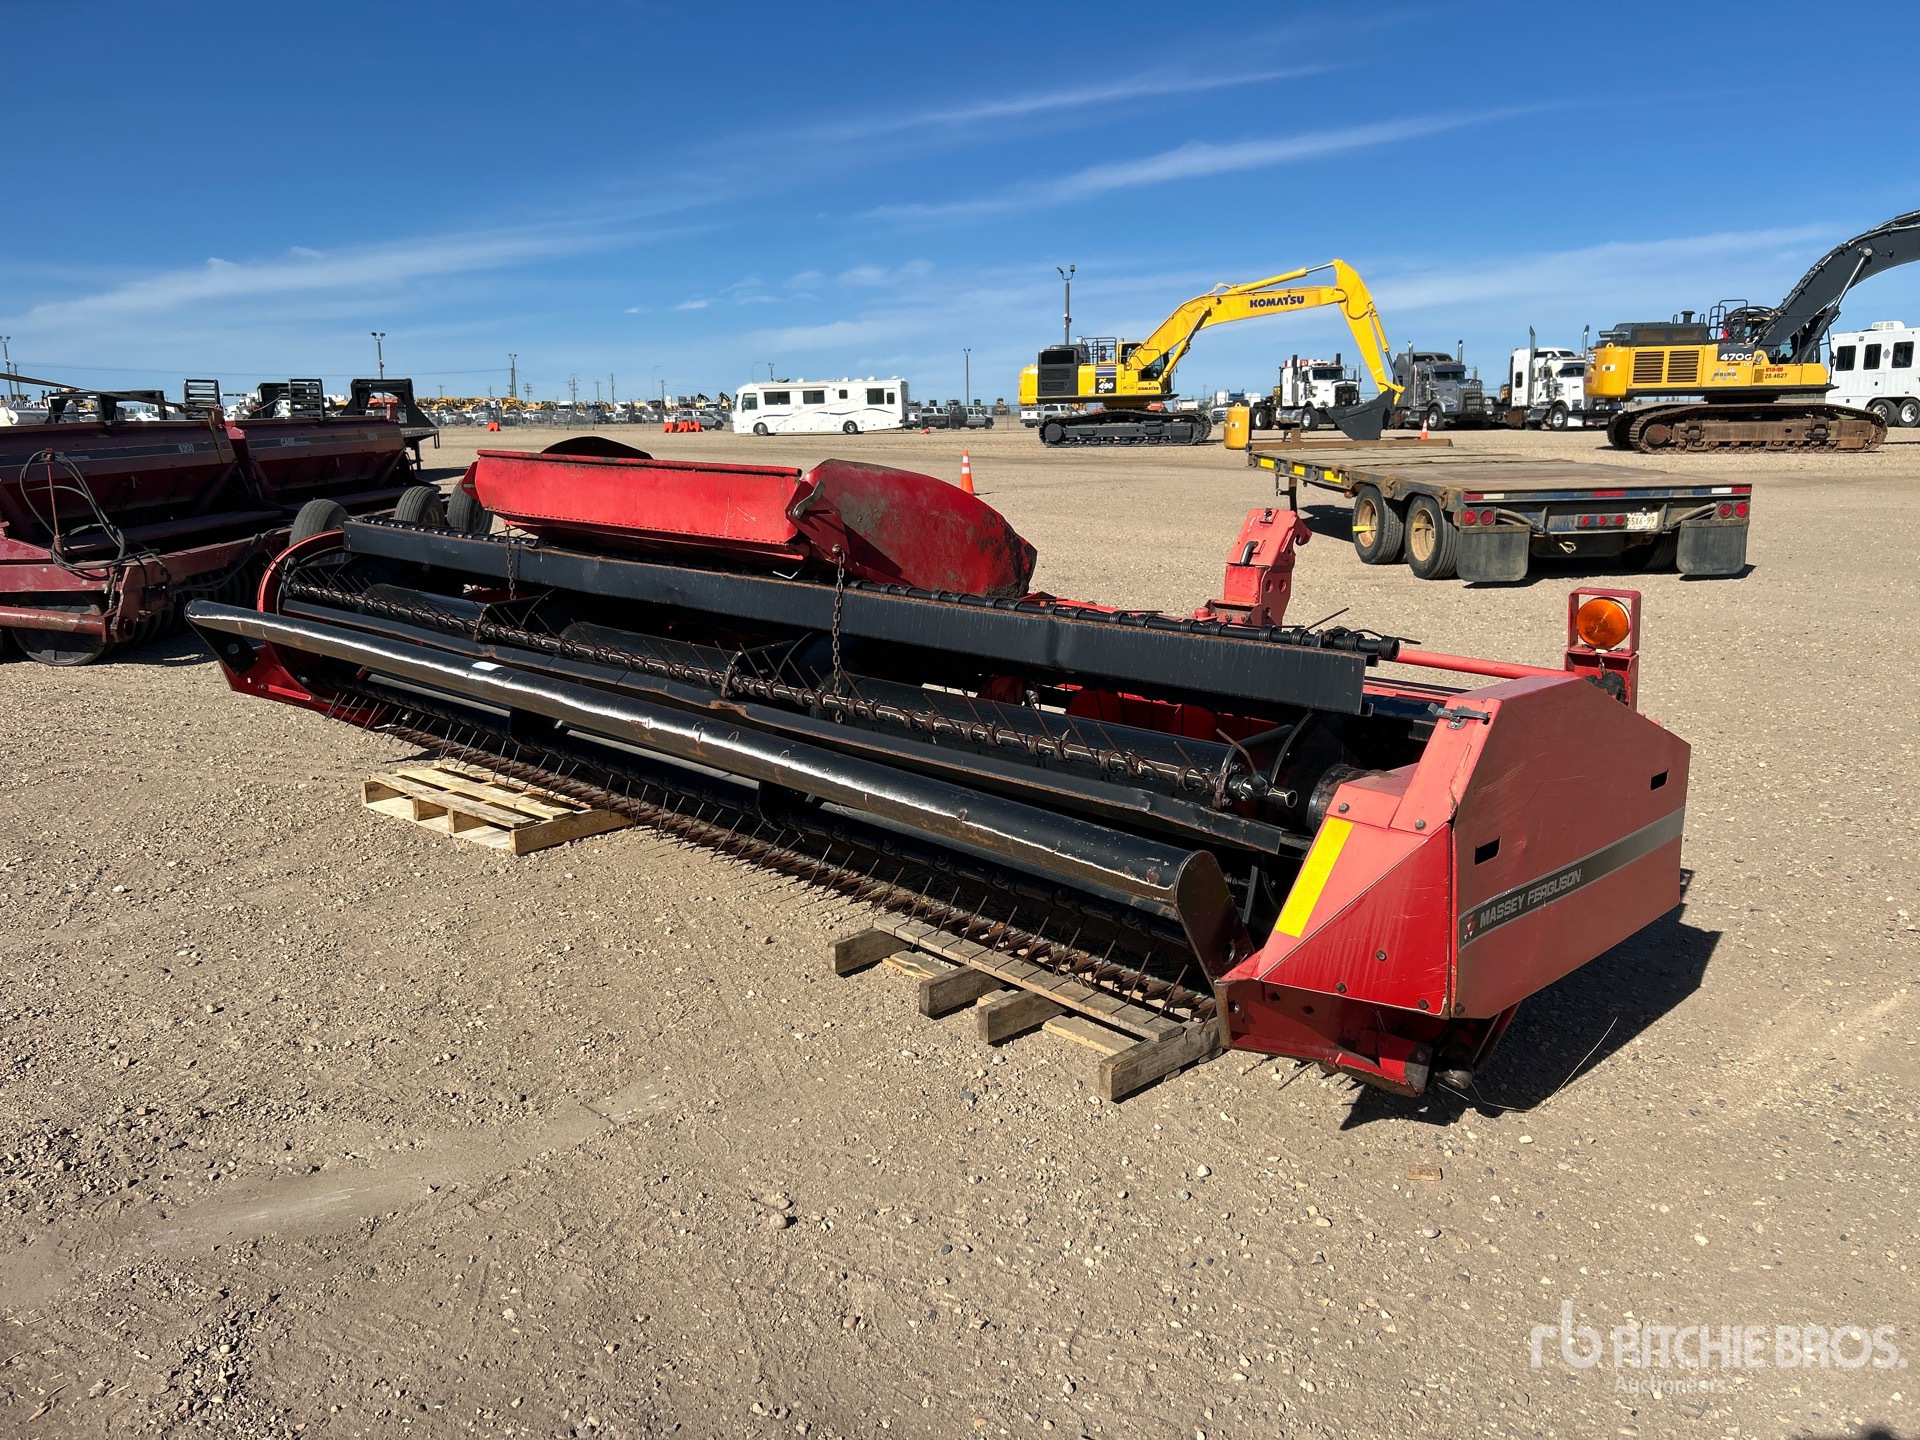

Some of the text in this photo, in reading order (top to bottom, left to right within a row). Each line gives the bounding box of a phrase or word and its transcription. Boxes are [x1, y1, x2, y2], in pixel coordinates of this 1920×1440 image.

[1250, 295, 1305, 308] KOMATSU
[1720, 353, 1752, 361] 470G
[1479, 868, 1582, 929] MASSEY FERGUSON
